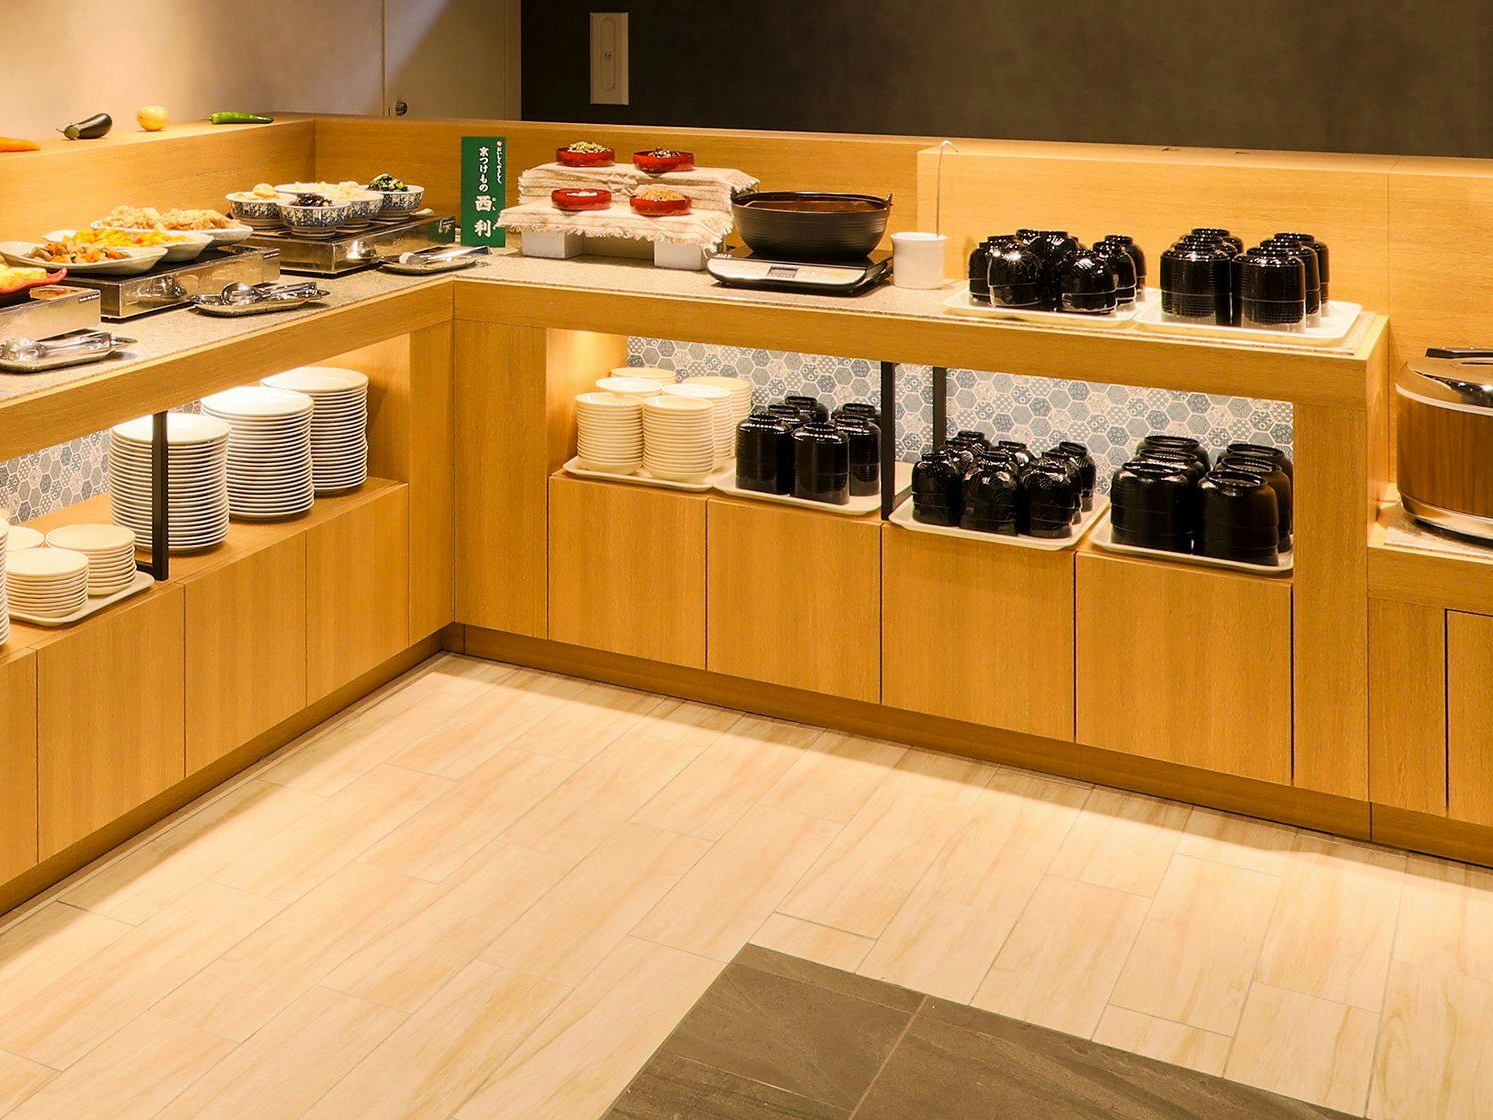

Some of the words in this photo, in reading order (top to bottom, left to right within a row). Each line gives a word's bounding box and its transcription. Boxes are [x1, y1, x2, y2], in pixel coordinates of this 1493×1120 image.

[479, 147, 489, 192] 京つけもの
[474, 195, 492, 237] 西利
